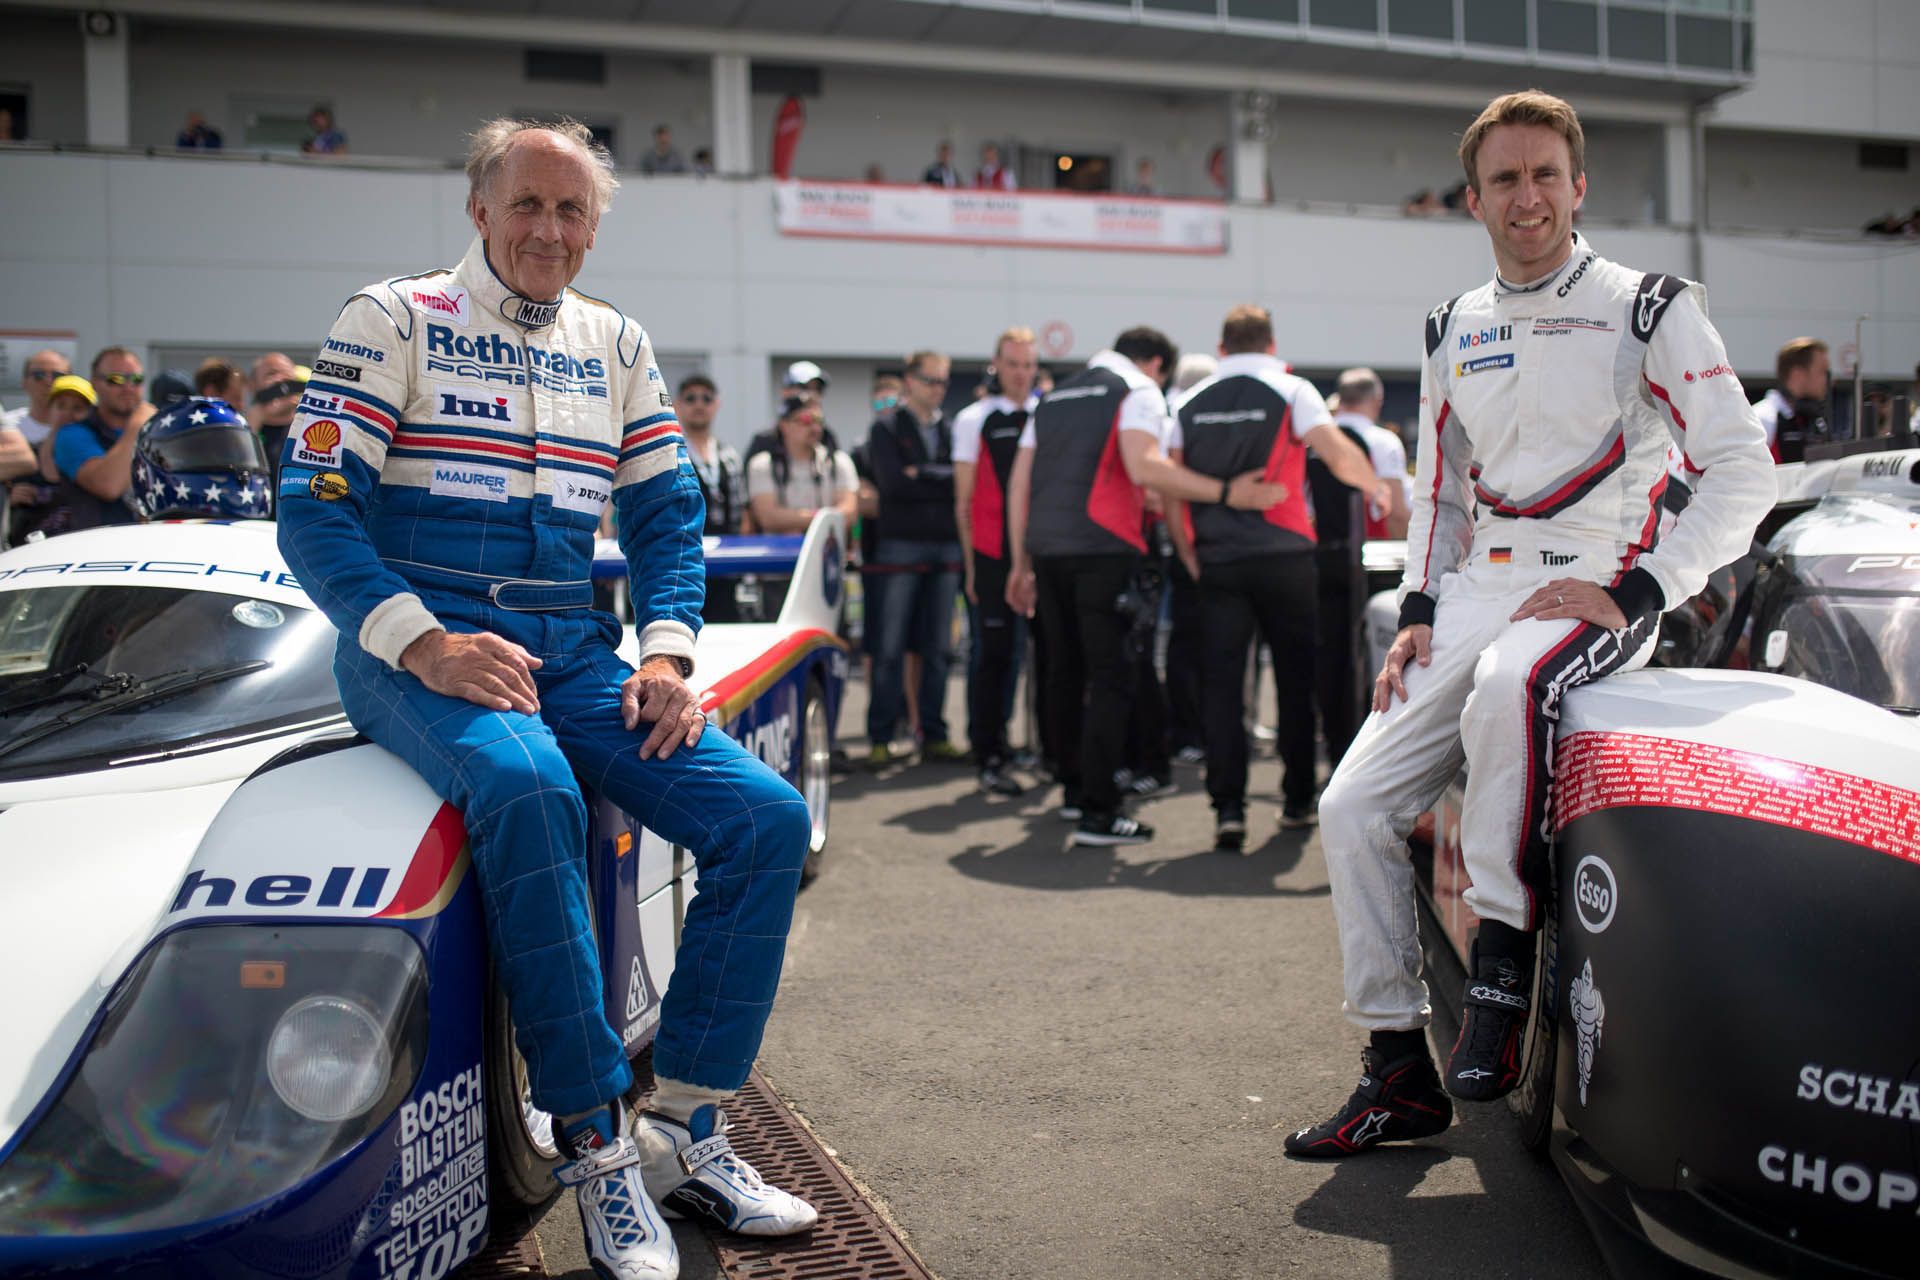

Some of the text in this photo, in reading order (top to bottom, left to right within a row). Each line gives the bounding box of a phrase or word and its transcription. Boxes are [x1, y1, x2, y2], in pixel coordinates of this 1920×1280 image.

[1459, 327, 1497, 350] Mobil
[1535, 316, 1608, 328] PORSCHE
[427, 322, 605, 378] Rothmans
[1472, 357, 1509, 370] MICHELIN
[427, 359, 608, 398] PORSCHE
[439, 393, 511, 422] lui
[298, 450, 336, 465] Shell
[435, 469, 506, 488] MAURER
[401, 1063, 483, 1147] BOSCH
[402, 1102, 484, 1188] BILSTEIN
[391, 1149, 484, 1228] speedline
[1757, 1145, 1920, 1217] CHOP
[374, 1174, 487, 1276] TELETRON
